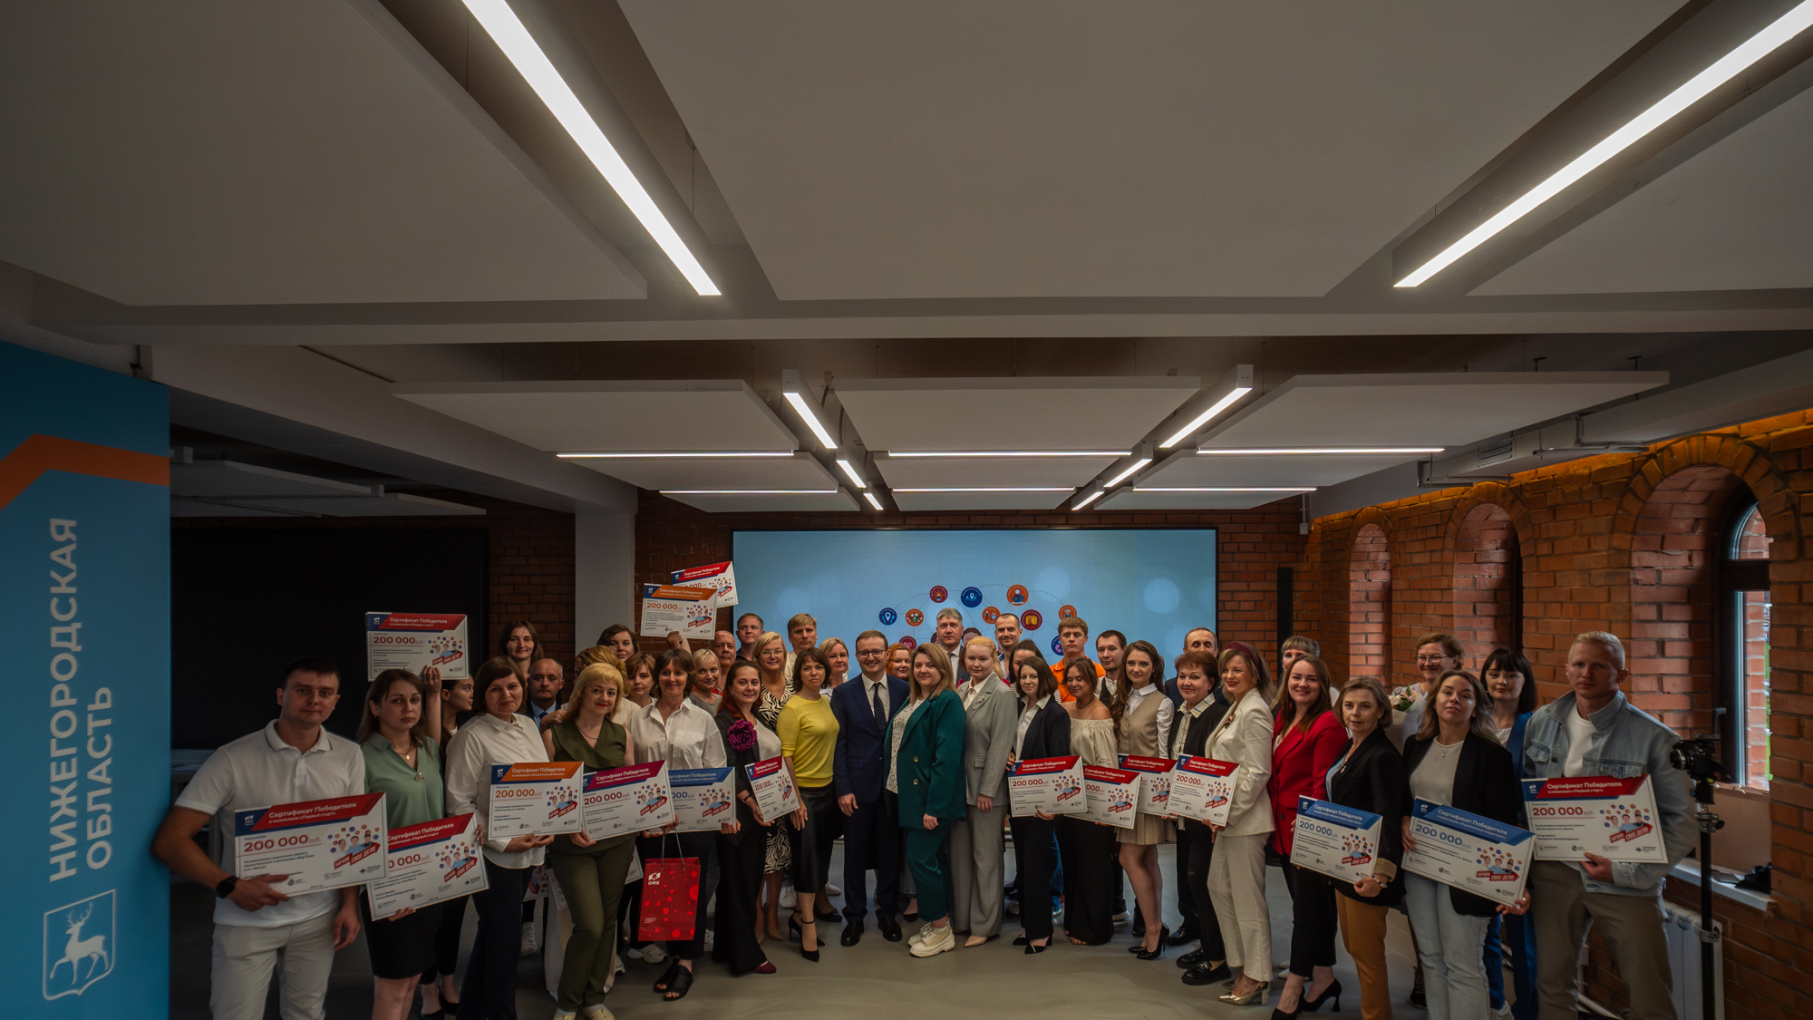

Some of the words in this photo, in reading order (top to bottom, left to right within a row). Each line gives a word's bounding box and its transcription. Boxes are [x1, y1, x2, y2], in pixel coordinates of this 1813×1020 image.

[50, 518, 82, 883] НИЖЕГОРОДСКАЯ
[86, 686, 112, 870] ОБЛАСТЬ
[596, 773, 622, 781] Сертификат
[623, 768, 649, 776] Победителя
[516, 789, 534, 797] 000
[584, 796, 602, 805] 200
[604, 792, 622, 801] 000
[269, 809, 313, 819] Сертификат
[315, 803, 356, 816] Победителя
[1314, 805, 1338, 814] Сертификат
[1338, 811, 1363, 821] Победителя
[1533, 807, 1556, 816] 200
[1558, 807, 1583, 815] 000
[1300, 821, 1314, 831] 200
[1316, 825, 1332, 836] 000
[1438, 809, 1472, 824] Сертификат
[1473, 820, 1508, 835] Победителя
[388, 830, 421, 841] Сертификат
[422, 823, 454, 833] Победителя
[1416, 824, 1437, 837] 200
[1440, 832, 1462, 846] 000
[244, 839, 274, 852] 200
[278, 834, 308, 846] 000
[397, 854, 421, 866] 000
